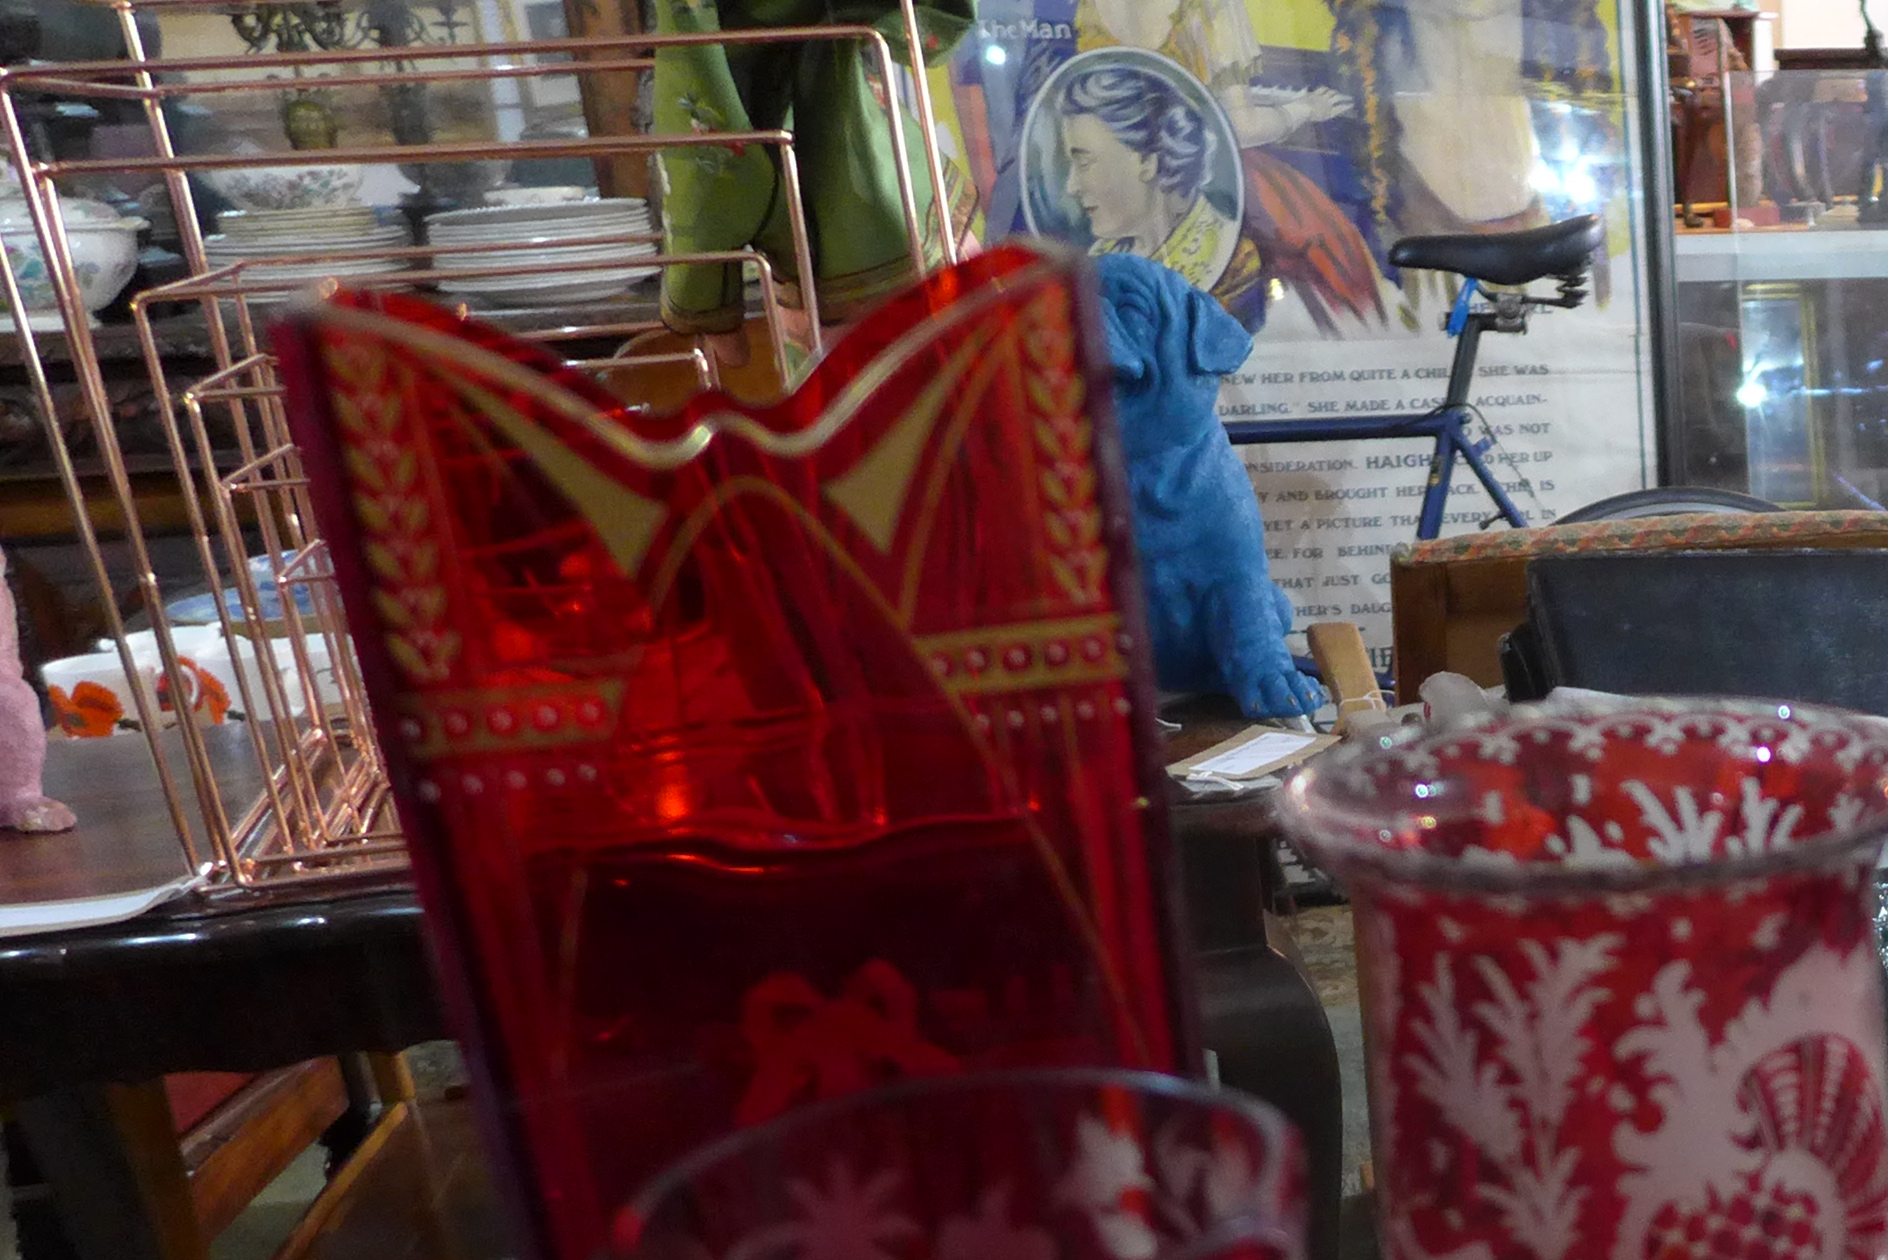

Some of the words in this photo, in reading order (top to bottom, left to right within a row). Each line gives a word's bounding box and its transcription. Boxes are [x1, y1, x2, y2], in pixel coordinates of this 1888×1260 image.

[1019, 20, 1072, 40] Man
[1221, 373, 1256, 385] NEW
[1261, 372, 1294, 384] HER
[1299, 370, 1345, 383] FROM
[1349, 368, 1396, 382] QUITE
[1401, 368, 1411, 379] A
[1415, 367, 1450, 379] CHIL
[1479, 366, 1510, 377] SHE
[1514, 364, 1549, 375] WAS
[1307, 401, 1339, 413] SHE
[1344, 399, 1391, 412] MADE
[1394, 398, 1405, 410] A
[1478, 424, 1514, 436] WAS
[1520, 423, 1551, 434] NOT
[1366, 454, 1433, 469] HAIGH
[1497, 452, 1529, 463] HER
[1533, 451, 1552, 462] UP
[1276, 491, 1308, 502] AND
[1314, 487, 1388, 501] BROUGHT
[1540, 480, 1555, 491] IS
[1264, 519, 1292, 532] YET
[1300, 518, 1311, 530] A
[1316, 516, 1382, 530] PICTURE
[1390, 515, 1421, 526] THA
[1541, 508, 1556, 520] IN
[1292, 547, 1323, 559] FOR
[1272, 576, 1314, 589] THAT
[1322, 574, 1359, 587] JUST
[1351, 602, 1391, 615] DAUG
